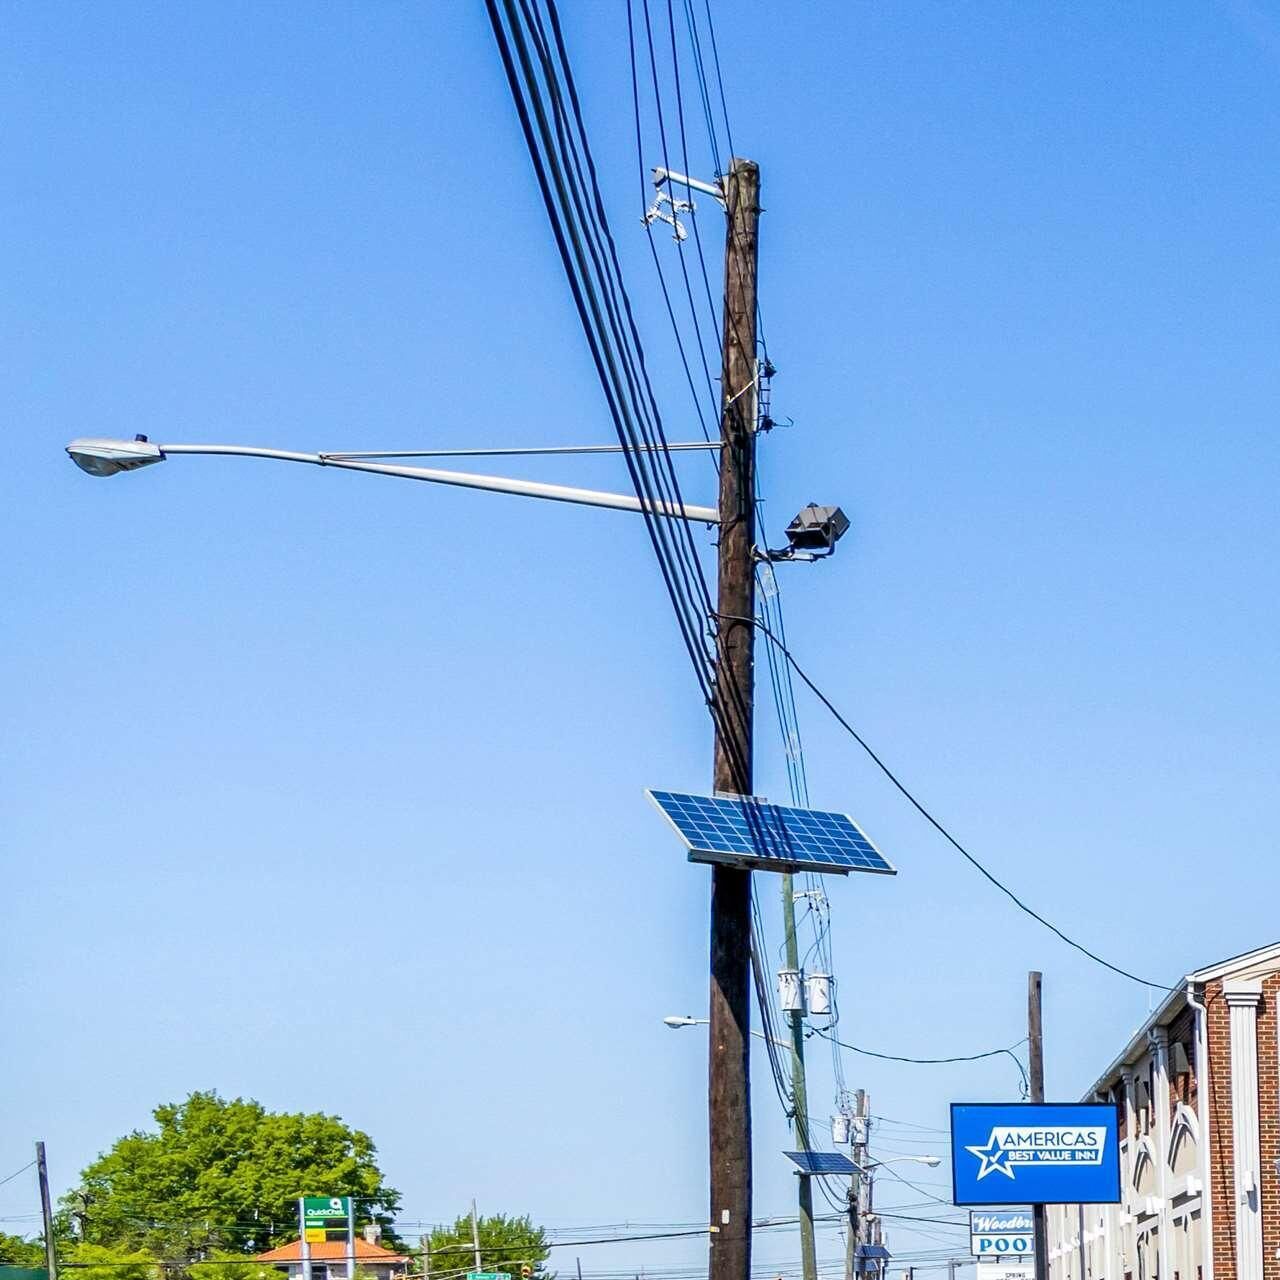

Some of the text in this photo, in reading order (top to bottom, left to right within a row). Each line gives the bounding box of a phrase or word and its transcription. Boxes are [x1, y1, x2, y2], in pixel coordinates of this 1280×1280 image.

[1003, 1131, 1098, 1147] AMERICAS
[1008, 1151, 1096, 1161] BEST VALUE INN
